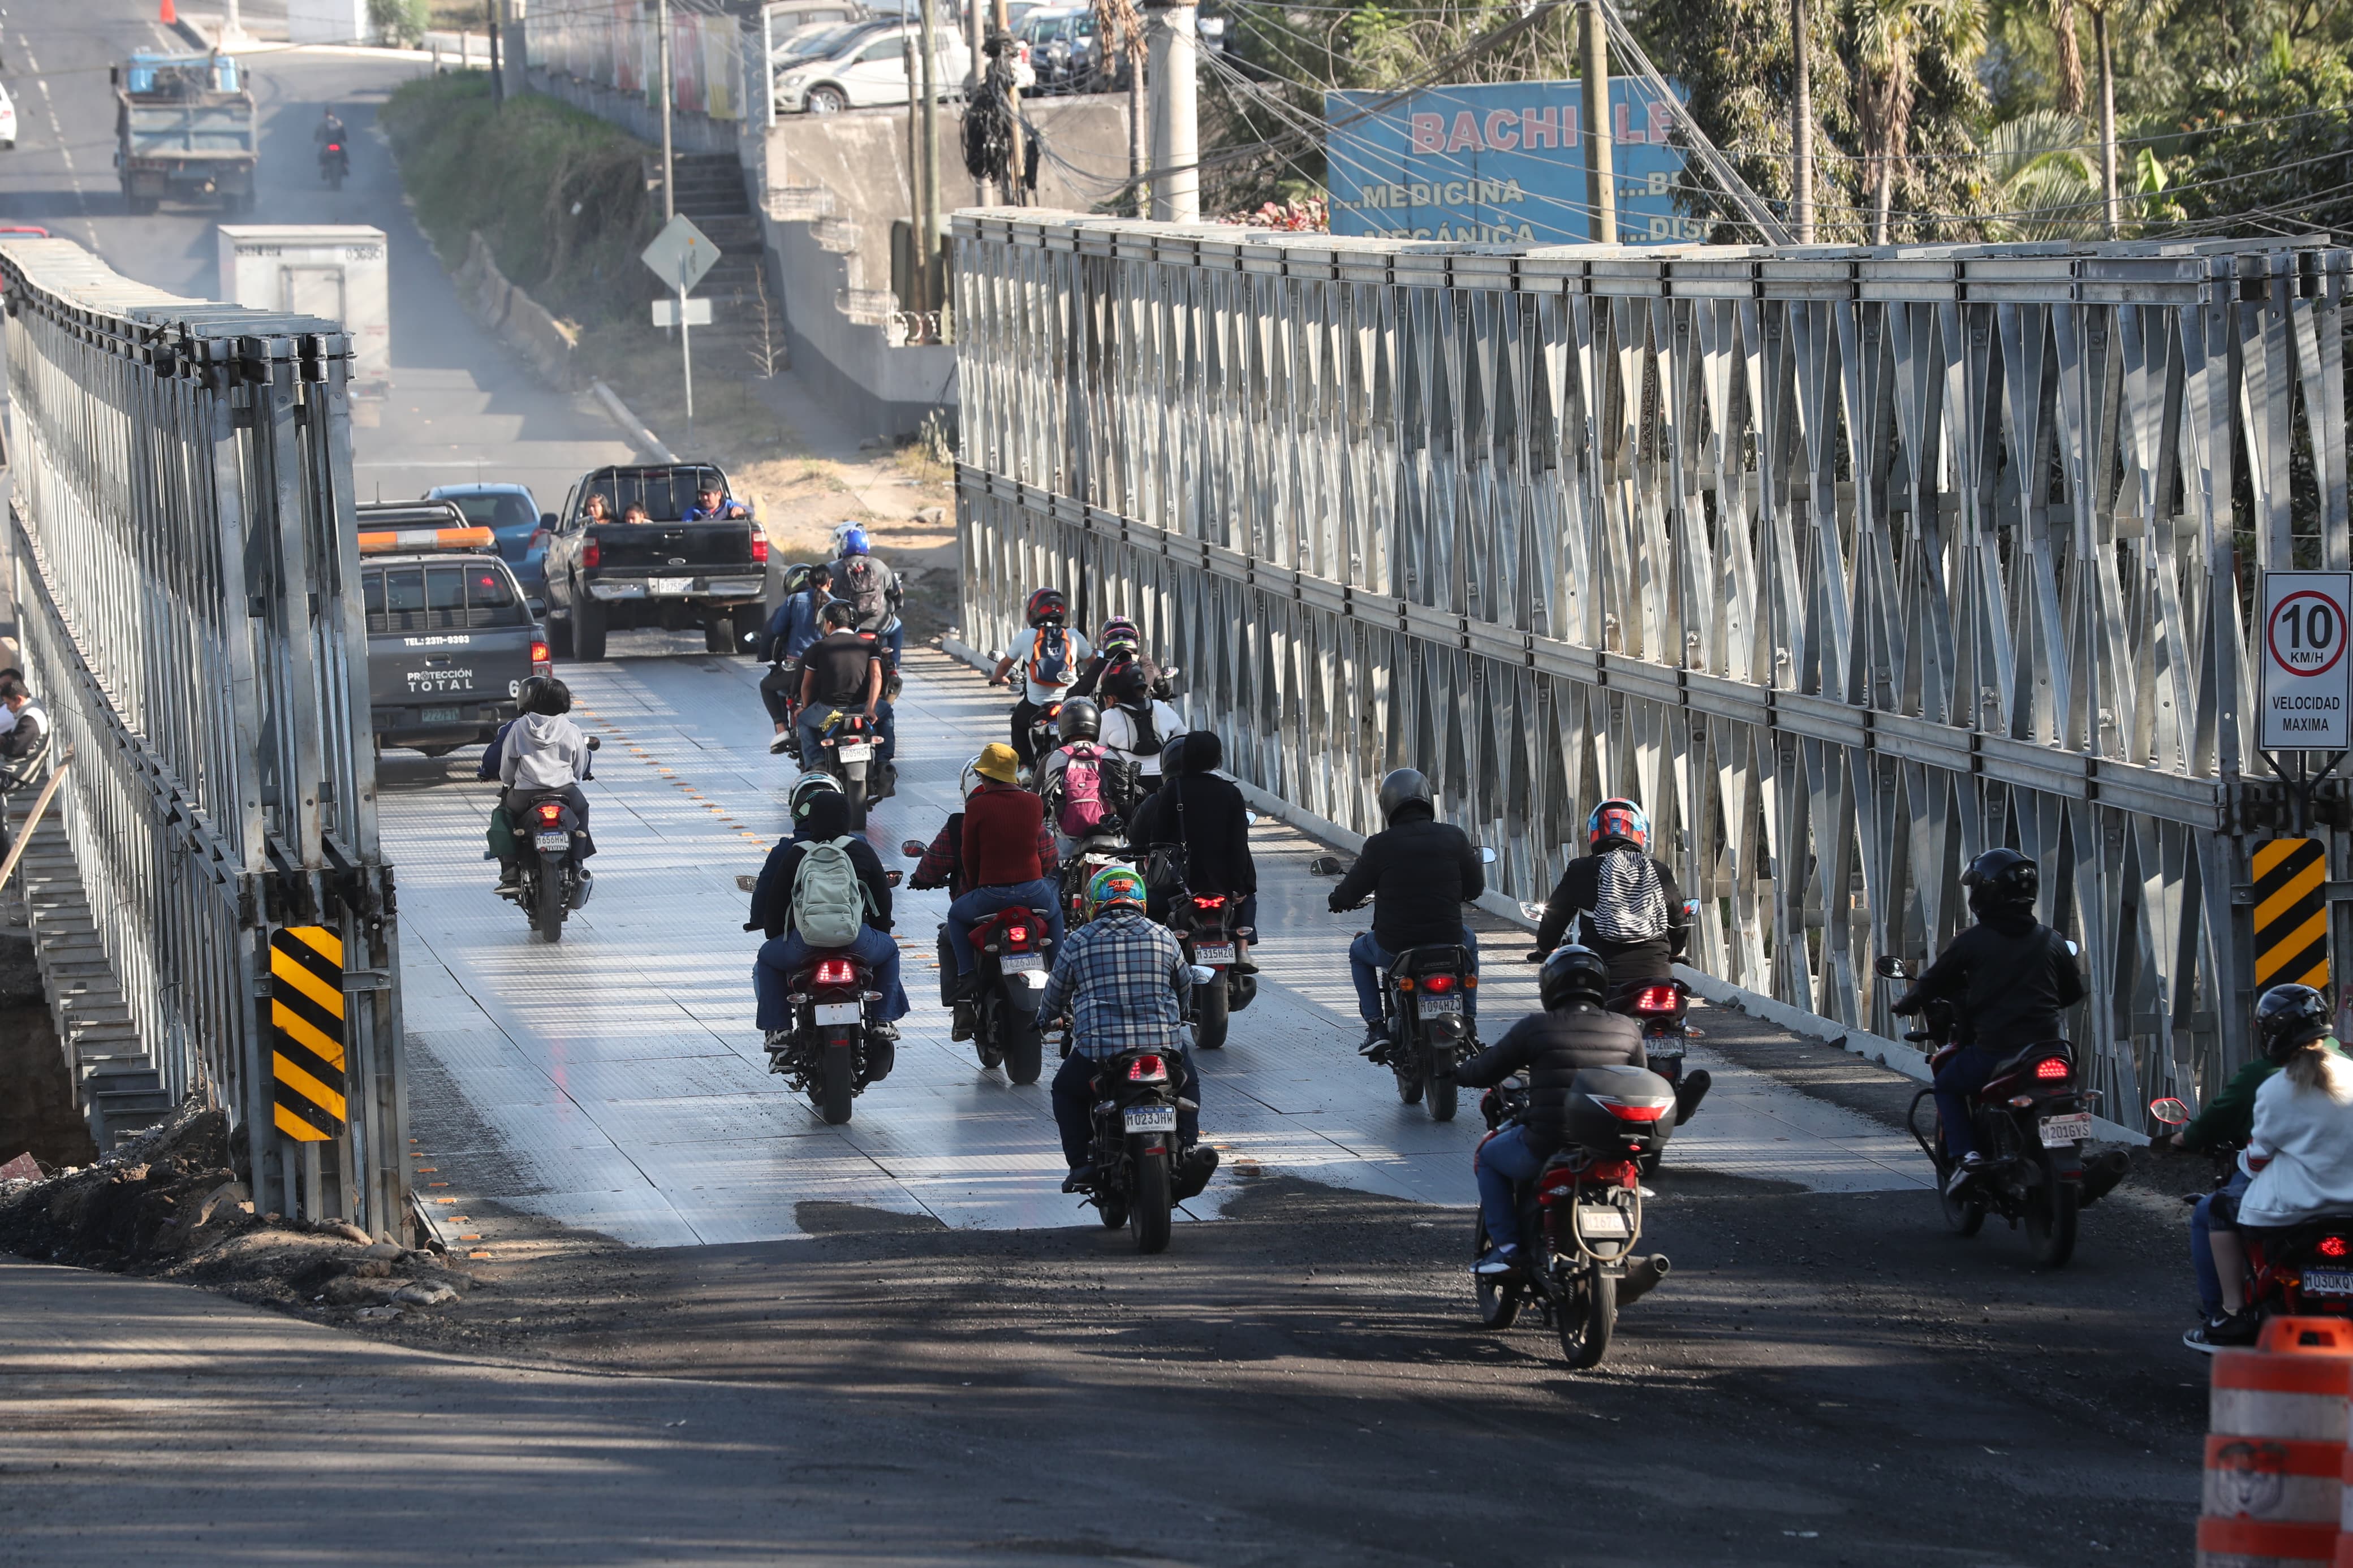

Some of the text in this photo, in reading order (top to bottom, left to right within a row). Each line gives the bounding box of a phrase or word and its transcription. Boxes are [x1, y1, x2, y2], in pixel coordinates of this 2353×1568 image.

[1412, 101, 1673, 154] BACHILE
[2282, 604, 2333, 649] 10
[404, 634, 470, 646] TEL.: 2311-9393
[2291, 652, 2324, 663] KM/H
[407, 668, 473, 681] PROTECCIÓN
[408, 679, 473, 693] TOTAL
[2272, 696, 2341, 710] VELOCIDAD
[2282, 718, 2329, 732] MAXIMA
[1196, 949, 1234, 960] M315HZQ
[1126, 1112, 1173, 1126] M023JHW
[2041, 1124, 2089, 1139] M201GYS
